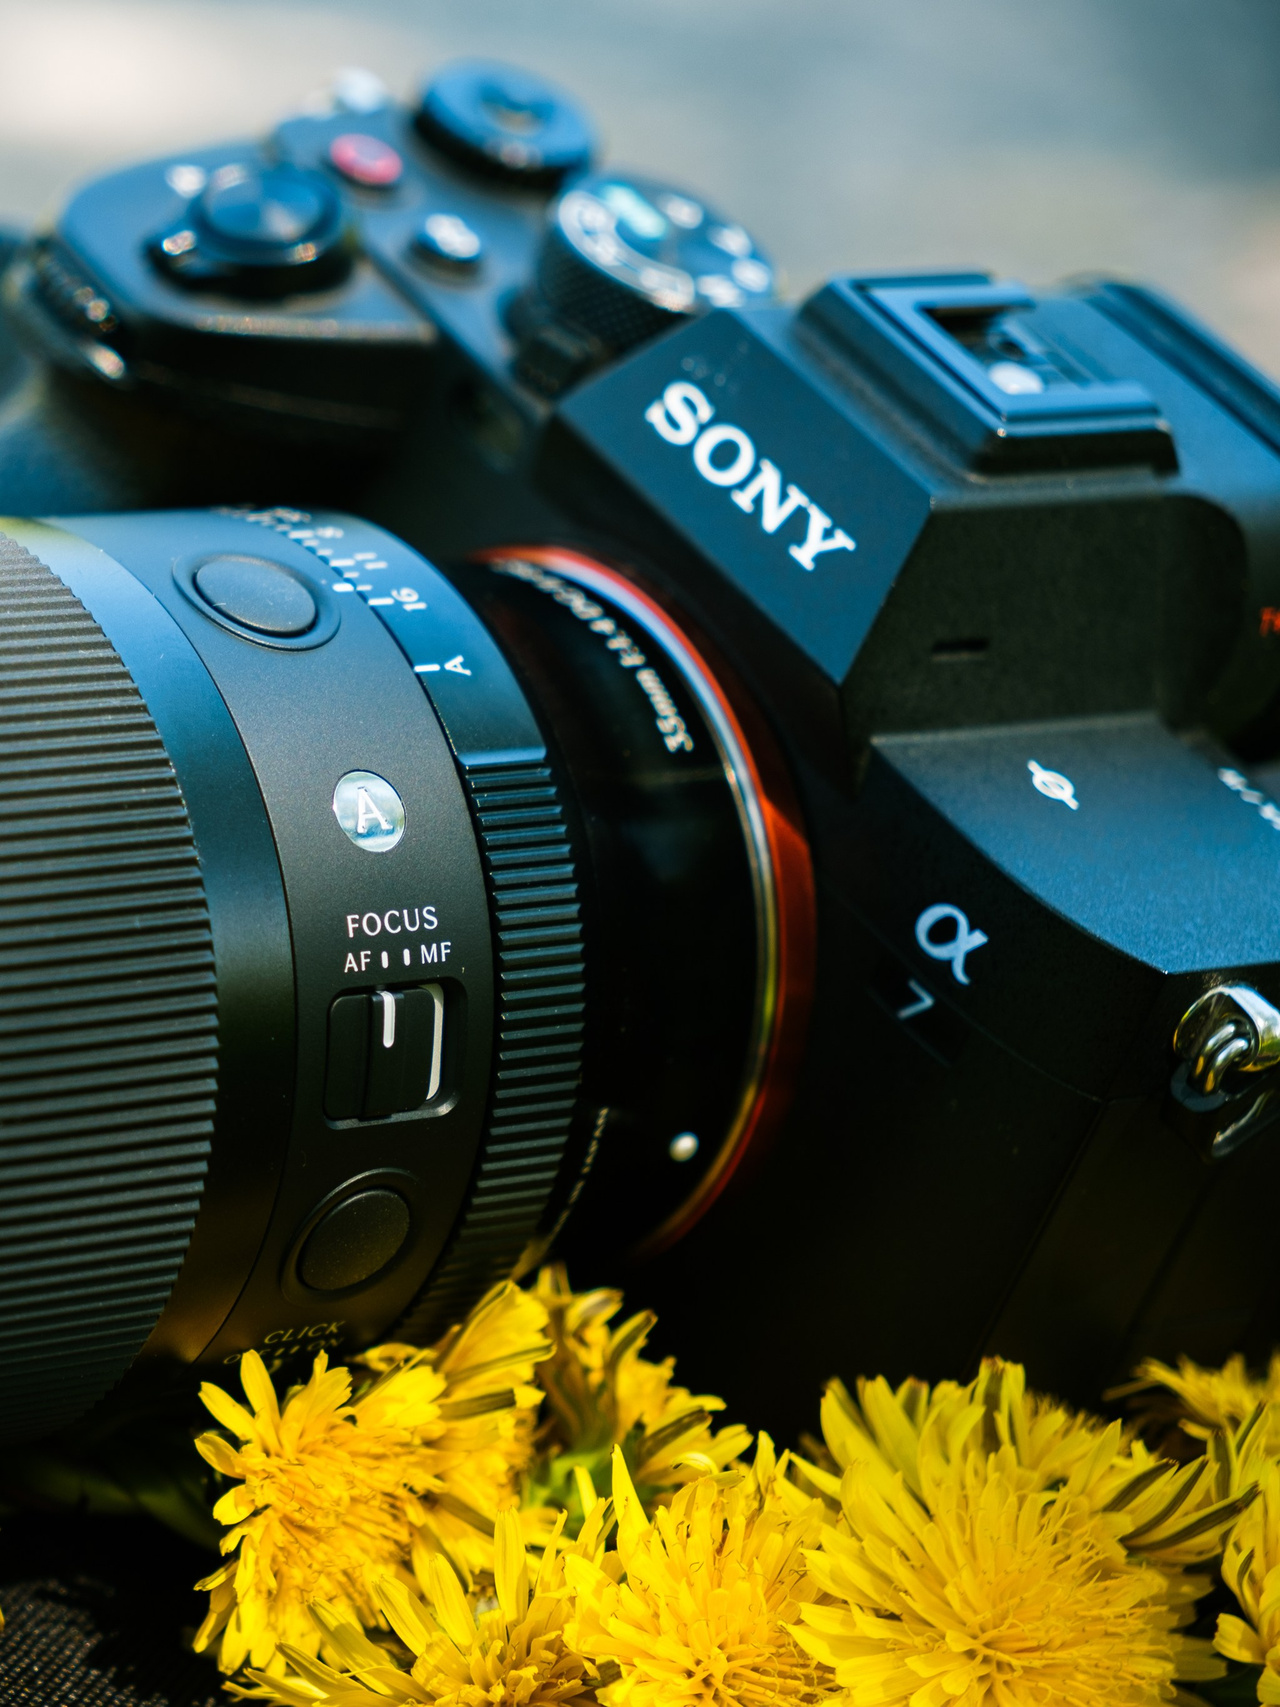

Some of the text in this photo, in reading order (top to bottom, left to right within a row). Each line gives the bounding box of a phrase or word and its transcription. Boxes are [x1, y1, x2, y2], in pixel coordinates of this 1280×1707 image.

[644, 381, 857, 572] SONY
[353, 552, 388, 570] 11
[391, 587, 427, 612] 16
[443, 654, 472, 676] A
[637, 668, 695, 753] 35mm
[356, 786, 393, 834] A
[346, 906, 439, 938] FOCUS
[344, 941, 452, 973] AF MF
[897, 979, 935, 1020] 7
[264, 1320, 346, 1345] CLICK
